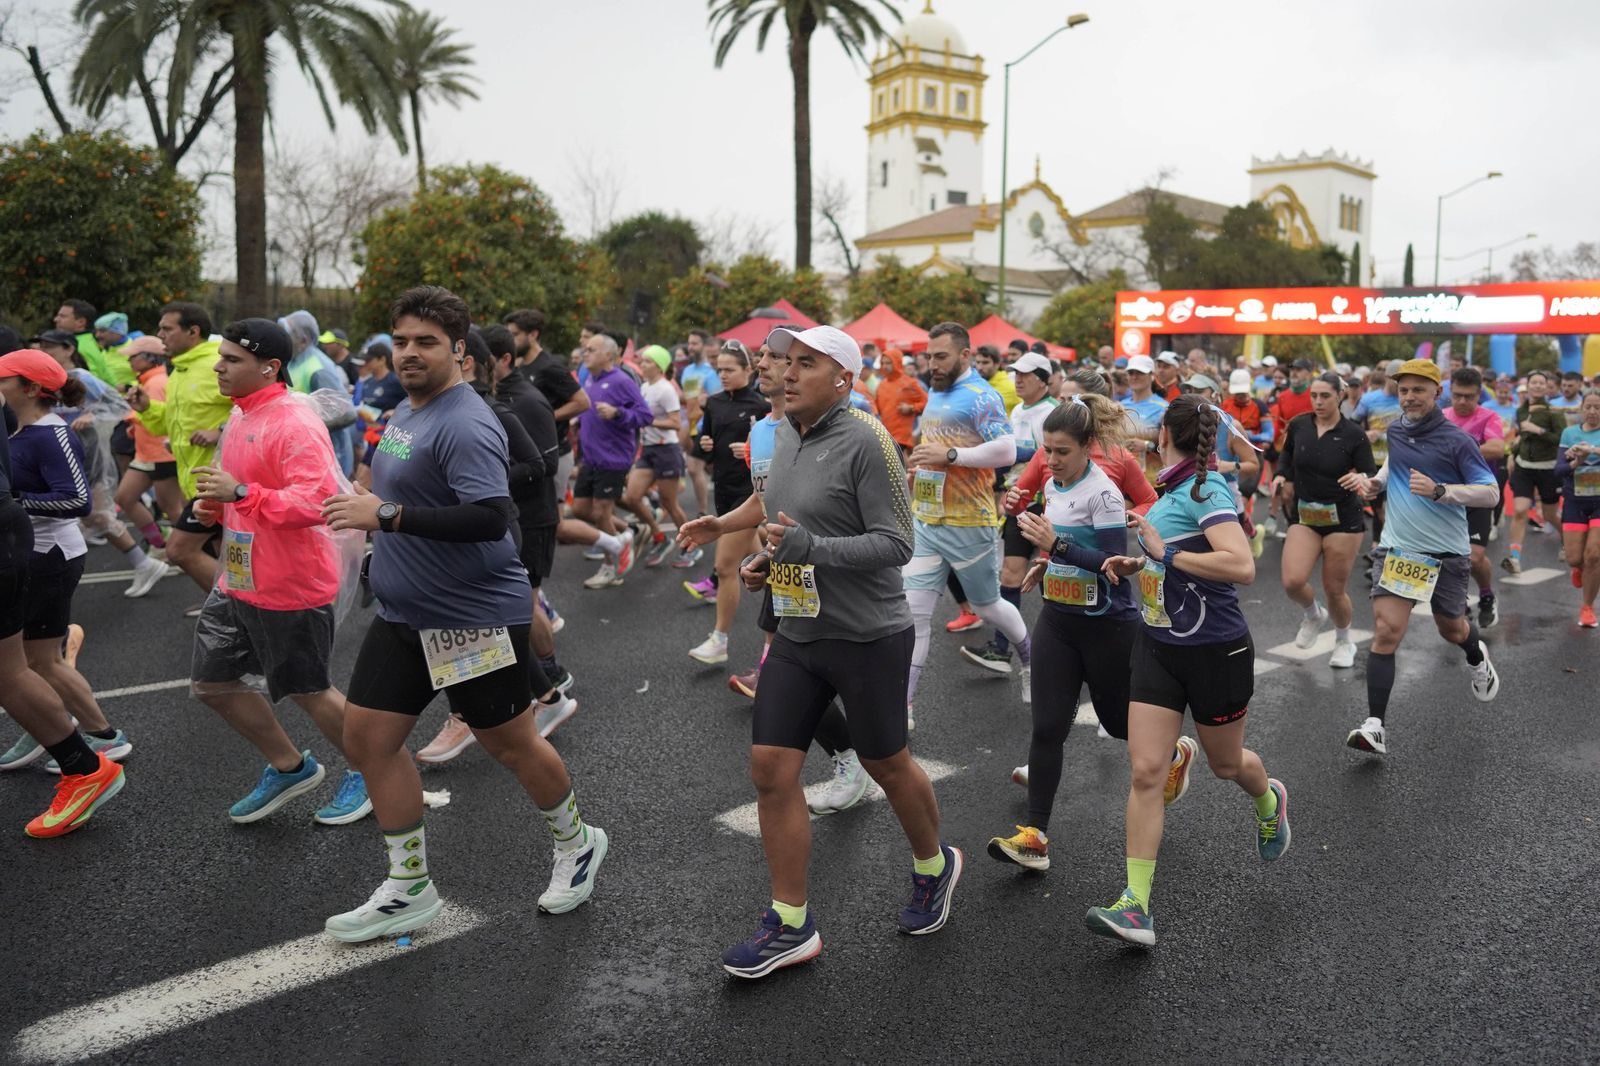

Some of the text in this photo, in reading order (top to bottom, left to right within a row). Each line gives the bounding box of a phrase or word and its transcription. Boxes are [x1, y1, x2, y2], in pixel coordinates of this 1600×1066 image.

[226, 544, 243, 565] 66
[1389, 559, 1430, 582] 18382
[1047, 576, 1081, 600] 8906
[1142, 574, 1158, 598] 161
